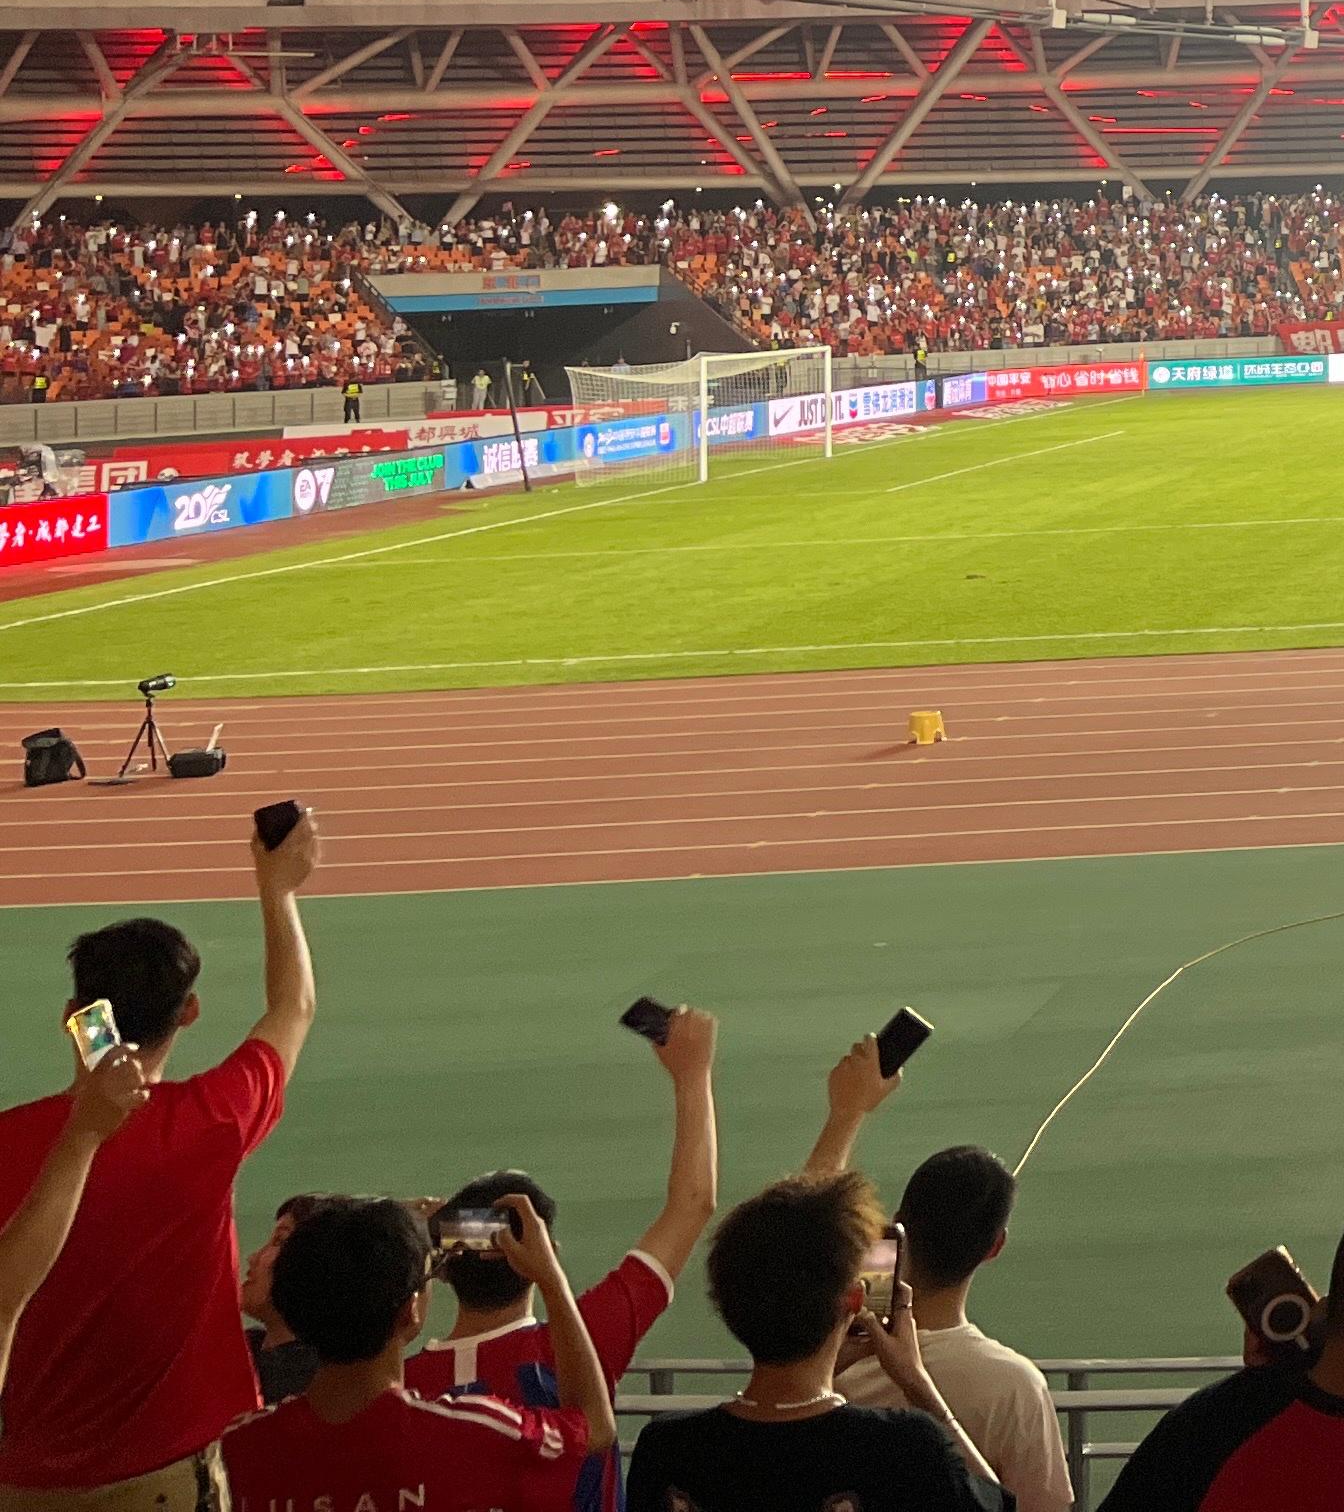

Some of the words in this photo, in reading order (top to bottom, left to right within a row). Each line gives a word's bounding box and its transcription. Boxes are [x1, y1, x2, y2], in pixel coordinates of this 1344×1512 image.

[1075, 370, 1103, 387] 省时
[1108, 368, 1139, 385] 省钱
[1171, 365, 1235, 382] 天府绿道
[863, 388, 914, 417] 雪佛龙润滑油
[798, 399, 819, 427] JUST
[211, 509, 230, 524] CSL
